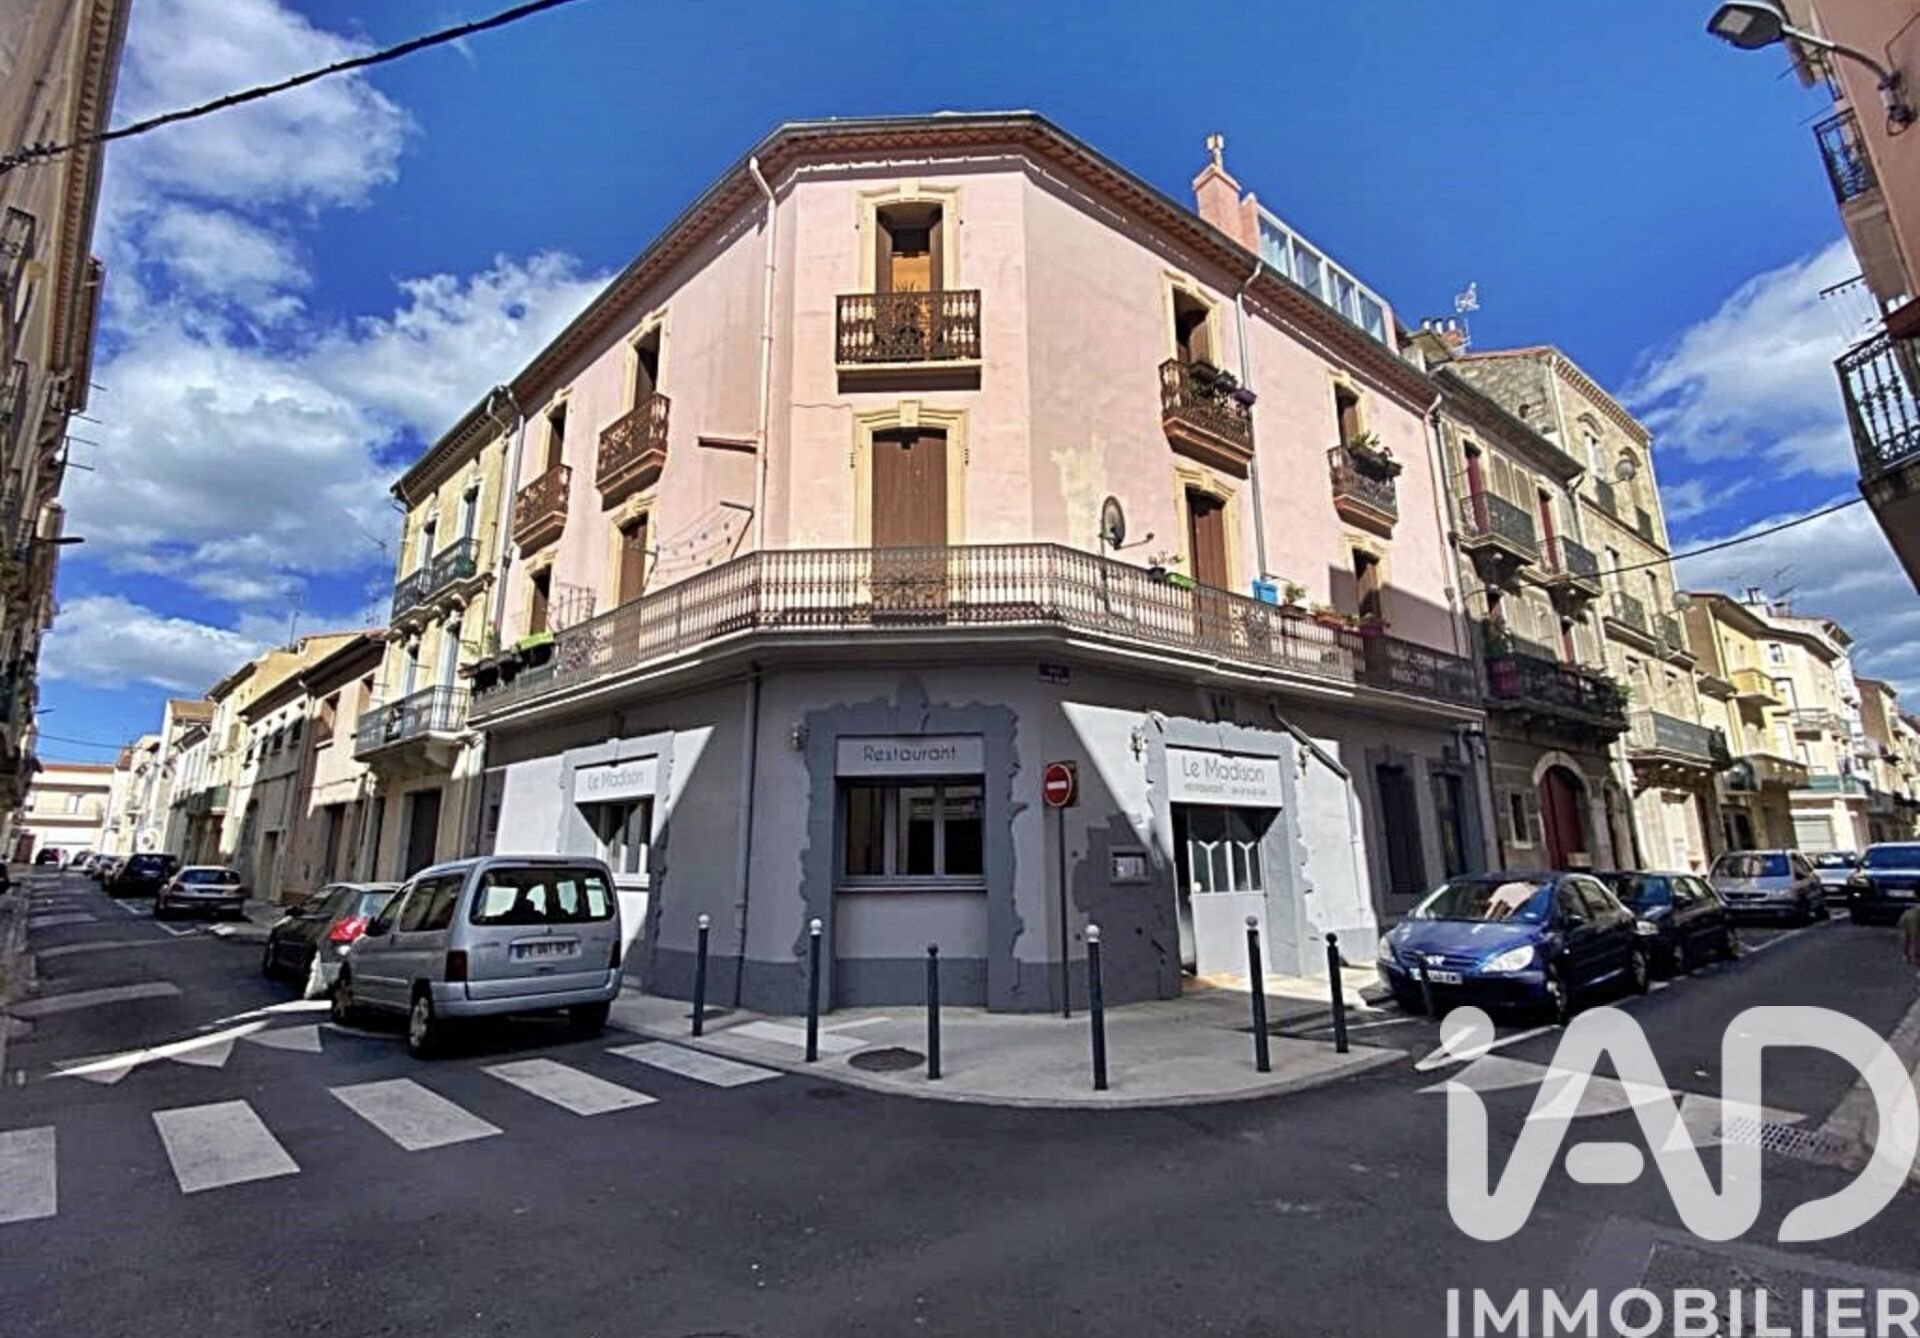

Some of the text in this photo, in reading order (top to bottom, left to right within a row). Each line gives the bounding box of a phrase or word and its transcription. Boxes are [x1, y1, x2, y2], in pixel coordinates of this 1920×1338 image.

[863, 744, 957, 762] Restaurant
[1182, 755, 1265, 783] Le Madison
